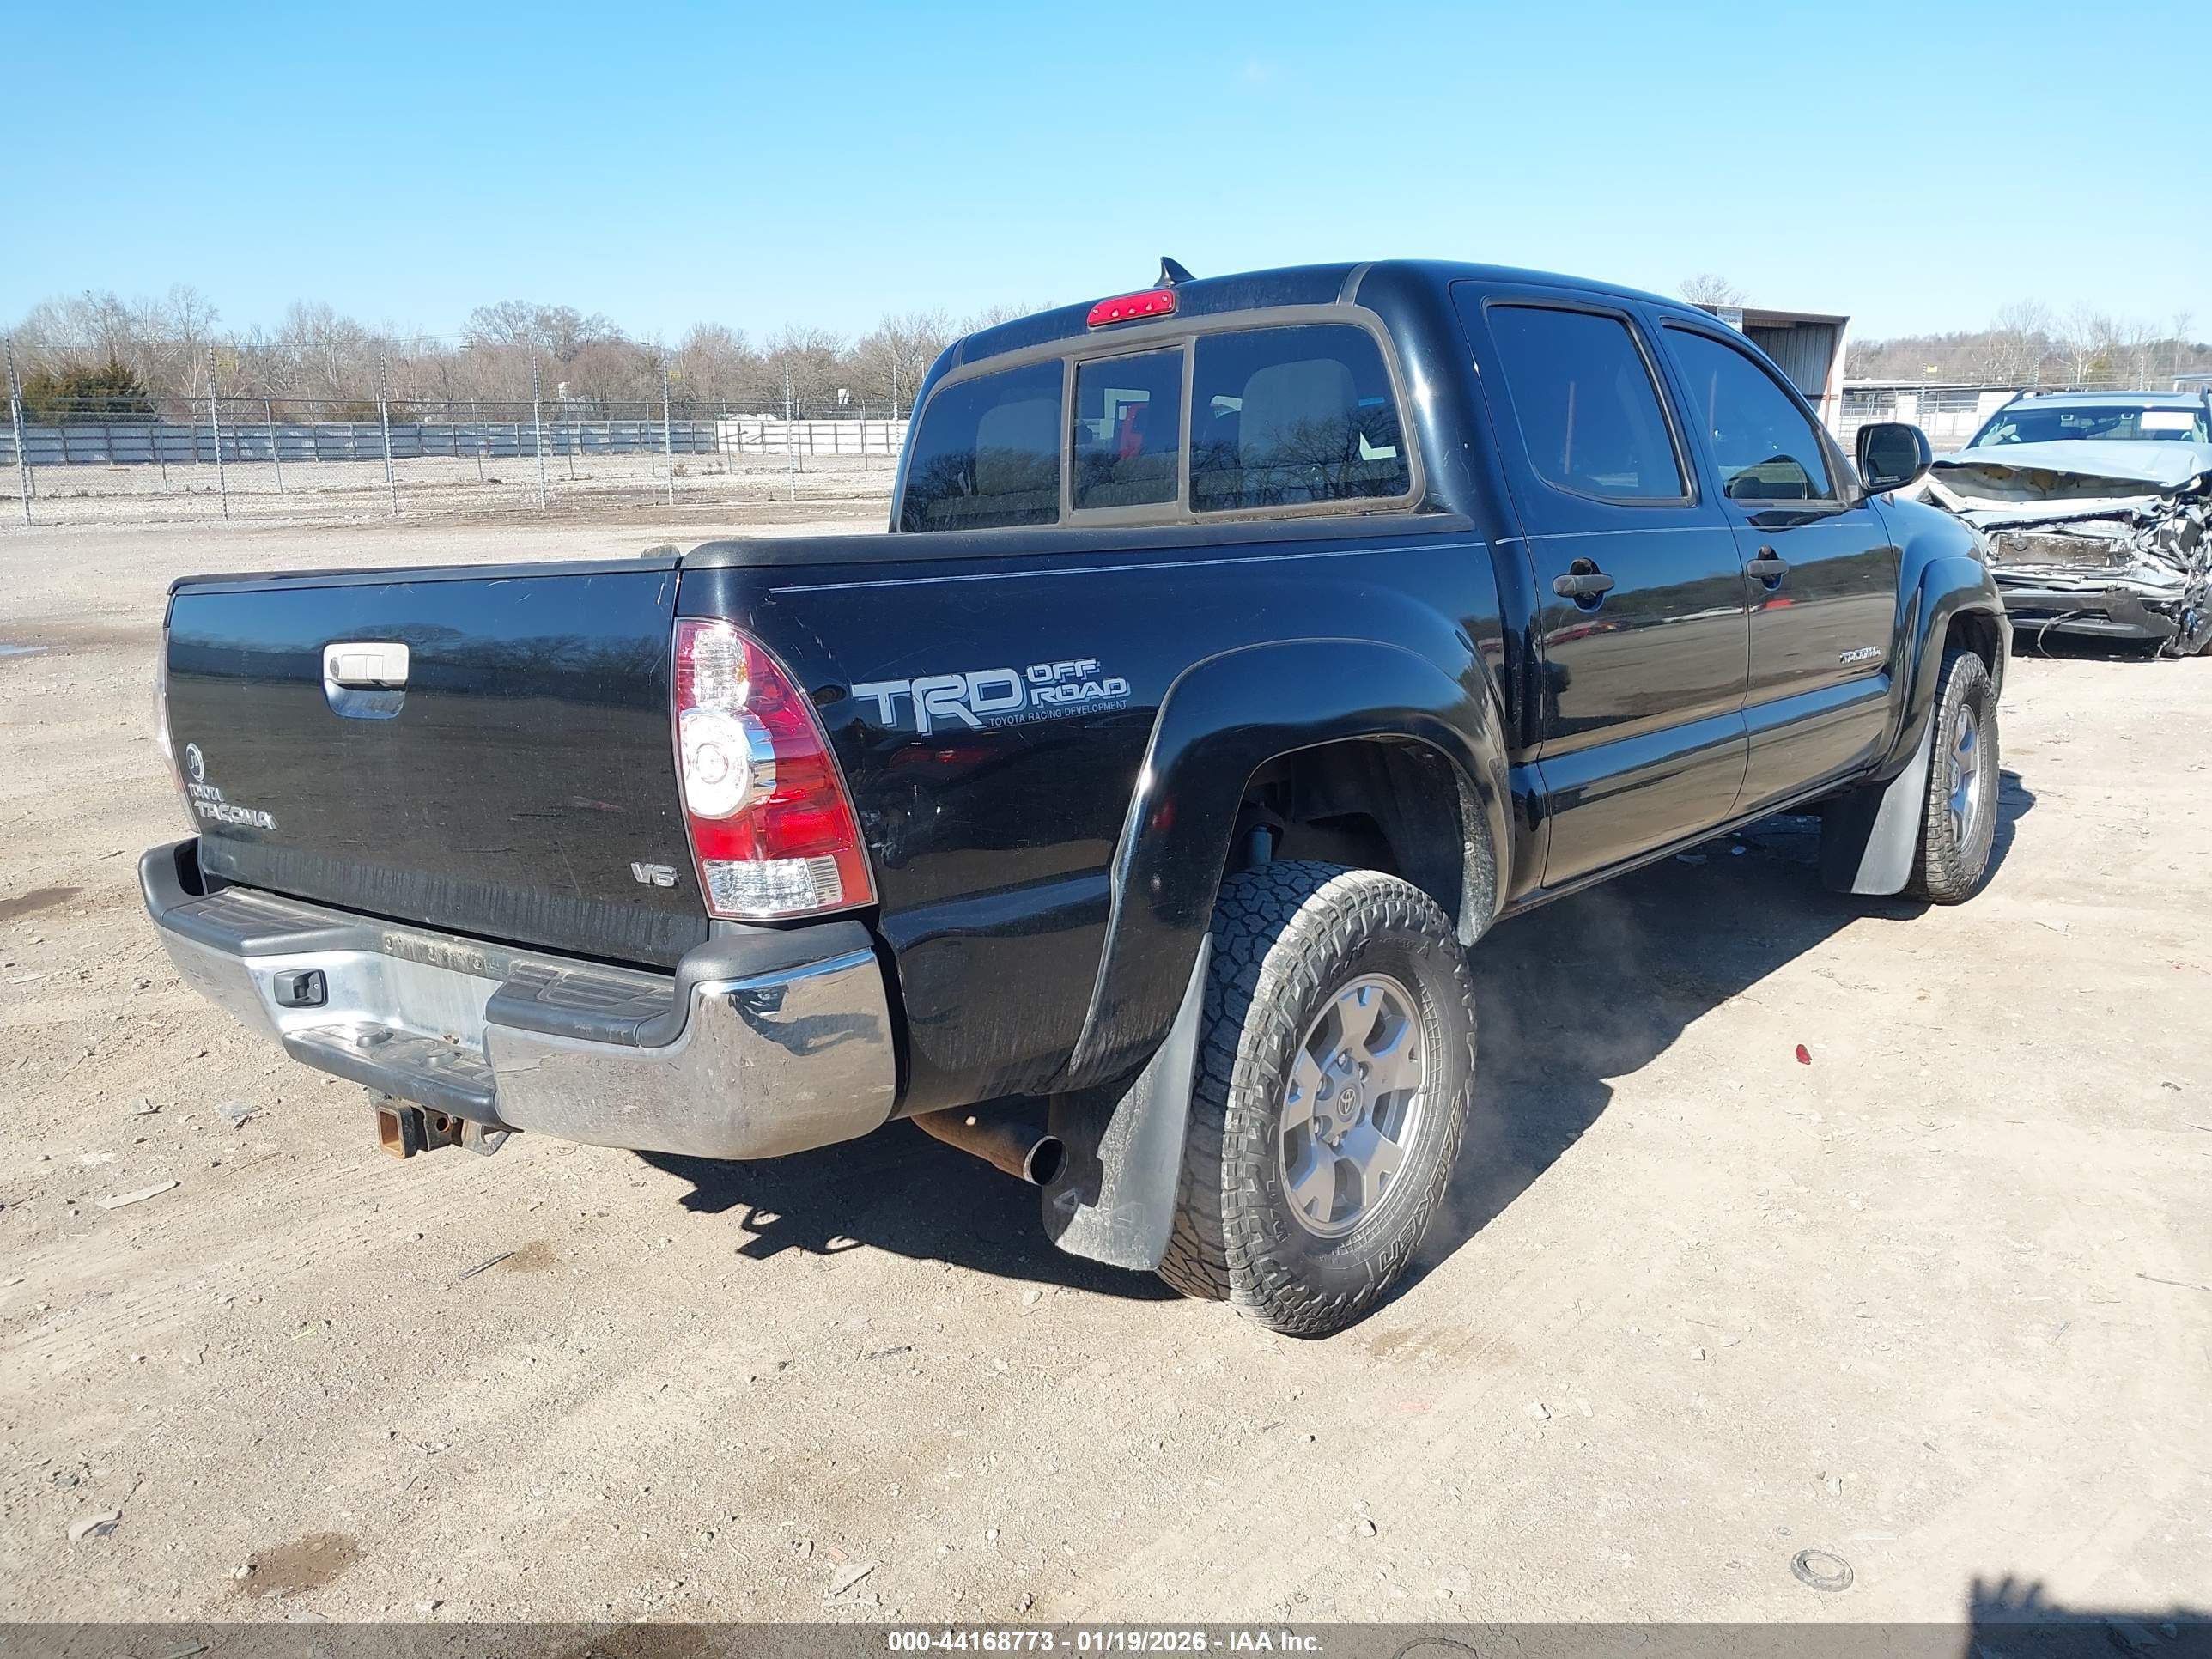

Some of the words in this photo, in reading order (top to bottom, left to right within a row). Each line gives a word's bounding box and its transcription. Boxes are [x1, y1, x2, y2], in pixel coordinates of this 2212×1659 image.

[852, 668, 1028, 738] TRD
[1026, 659, 1101, 684] OFF
[1030, 677, 1131, 708] ROAD
[988, 714, 1026, 727] TOYOTA
[1028, 708, 1062, 723] RACING
[1064, 700, 1128, 718] DEVELOPMENT
[188, 782, 225, 802] TOYOTA
[194, 800, 278, 830] TACOMA
[630, 862, 677, 887] V6
